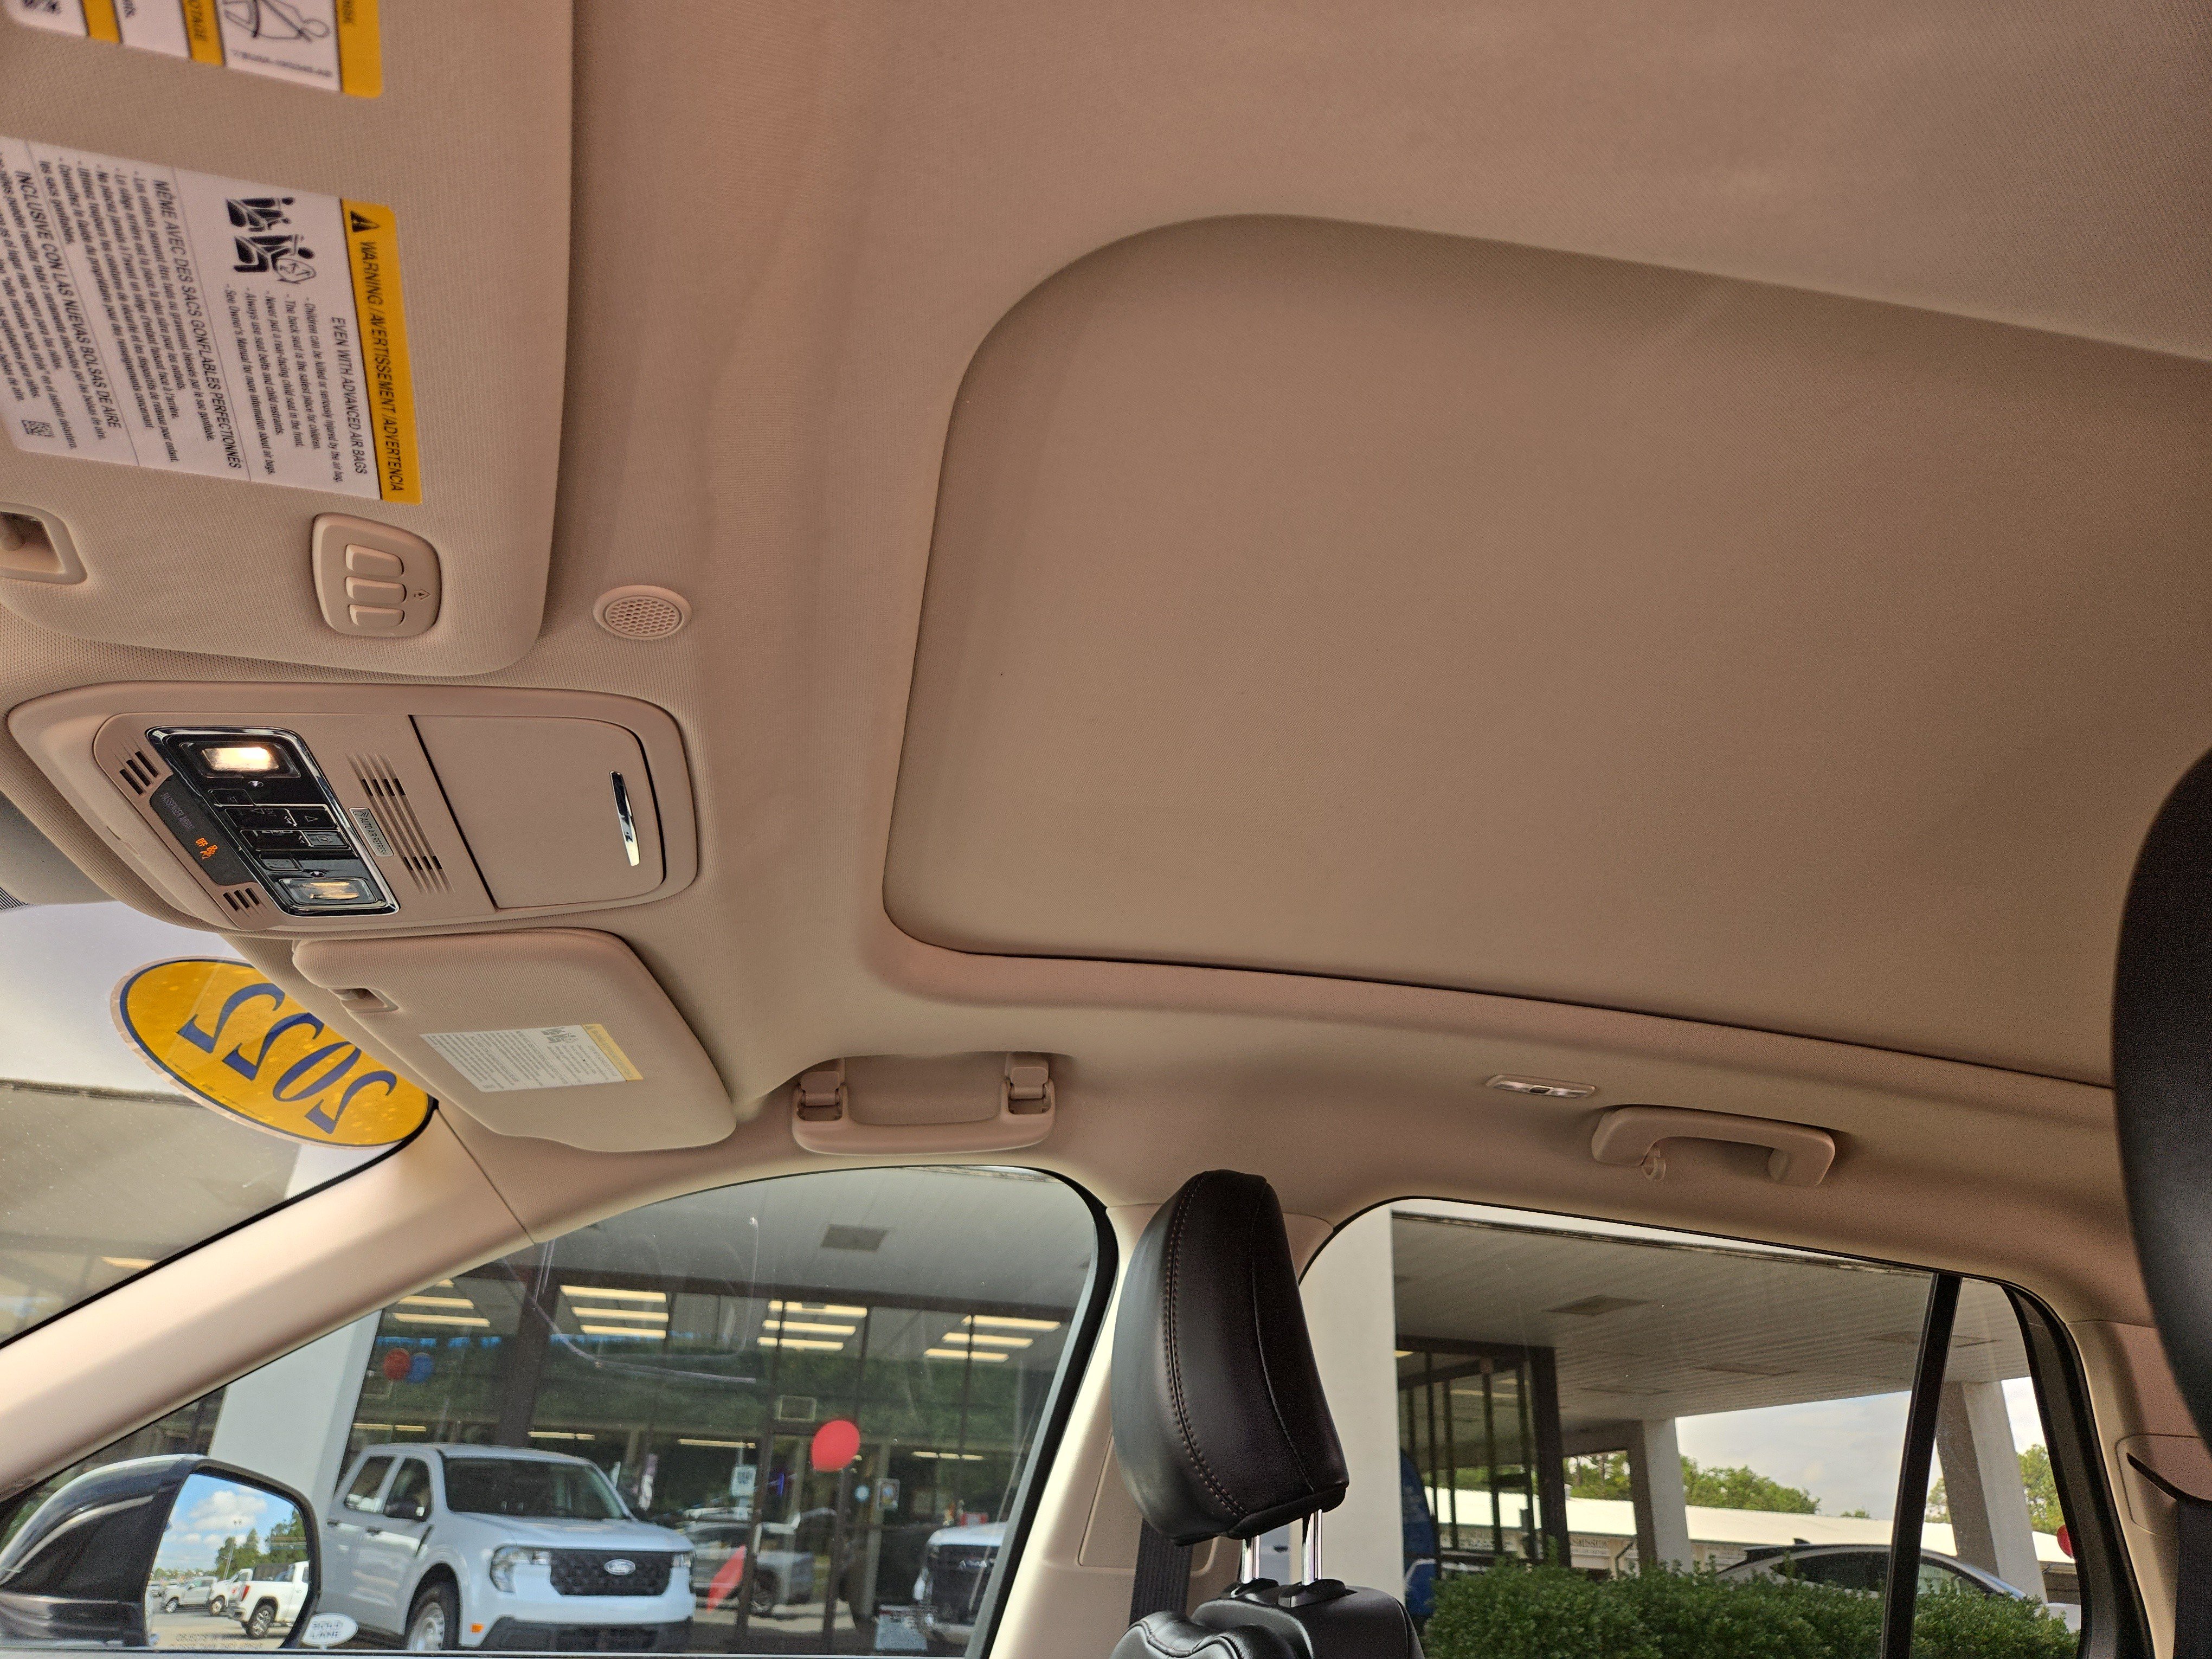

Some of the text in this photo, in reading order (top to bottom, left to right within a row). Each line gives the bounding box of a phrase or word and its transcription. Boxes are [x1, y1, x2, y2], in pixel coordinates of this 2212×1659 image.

[360, 242, 383, 305] WARNING
[16, 171, 121, 428] INCLUSIVE CON LAS NUEVAS BOLSAS DE AIRE
[224, 289, 237, 304] See
[265, 295, 277, 318] Never
[285, 300, 297, 314] The
[153, 179, 242, 469] MÊME AVEC DES SACS GONFLABLES PERFECTIONNÉS
[267, 319, 281, 332] put
[287, 315, 300, 334] back
[304, 303, 318, 334] Children
[236, 337, 252, 363] Manual
[291, 335, 304, 352] seat
[310, 336, 320, 349] can
[274, 339, 290, 378] rear-facing
[313, 350, 322, 359] be
[242, 364, 253, 375] for
[245, 292, 285, 435] Always use seat belts and child restraints.
[296, 360, 307, 372] the
[314, 361, 326, 380] killed
[246, 377, 256, 393] more
[281, 379, 294, 396] child
[299, 373, 312, 395] safest
[285, 396, 298, 411] seat
[301, 395, 314, 413] place
[319, 389, 333, 419] seriously
[331, 317, 368, 474] EVEN WITH ADVANCED AIR BAGS
[249, 394, 266, 430] information
[306, 414, 317, 423] for
[290, 420, 300, 430] the
[324, 420, 338, 441] injured
[258, 431, 271, 449] about
[293, 431, 305, 447] front.
[308, 423, 321, 450] children.
[262, 449, 272, 459] air
[327, 441, 338, 450] by
[331, 451, 340, 461] the
[264, 459, 275, 475] bags.
[332, 461, 342, 470] air
[332, 470, 343, 483] bag.
[196, 838, 208, 847] OFF
